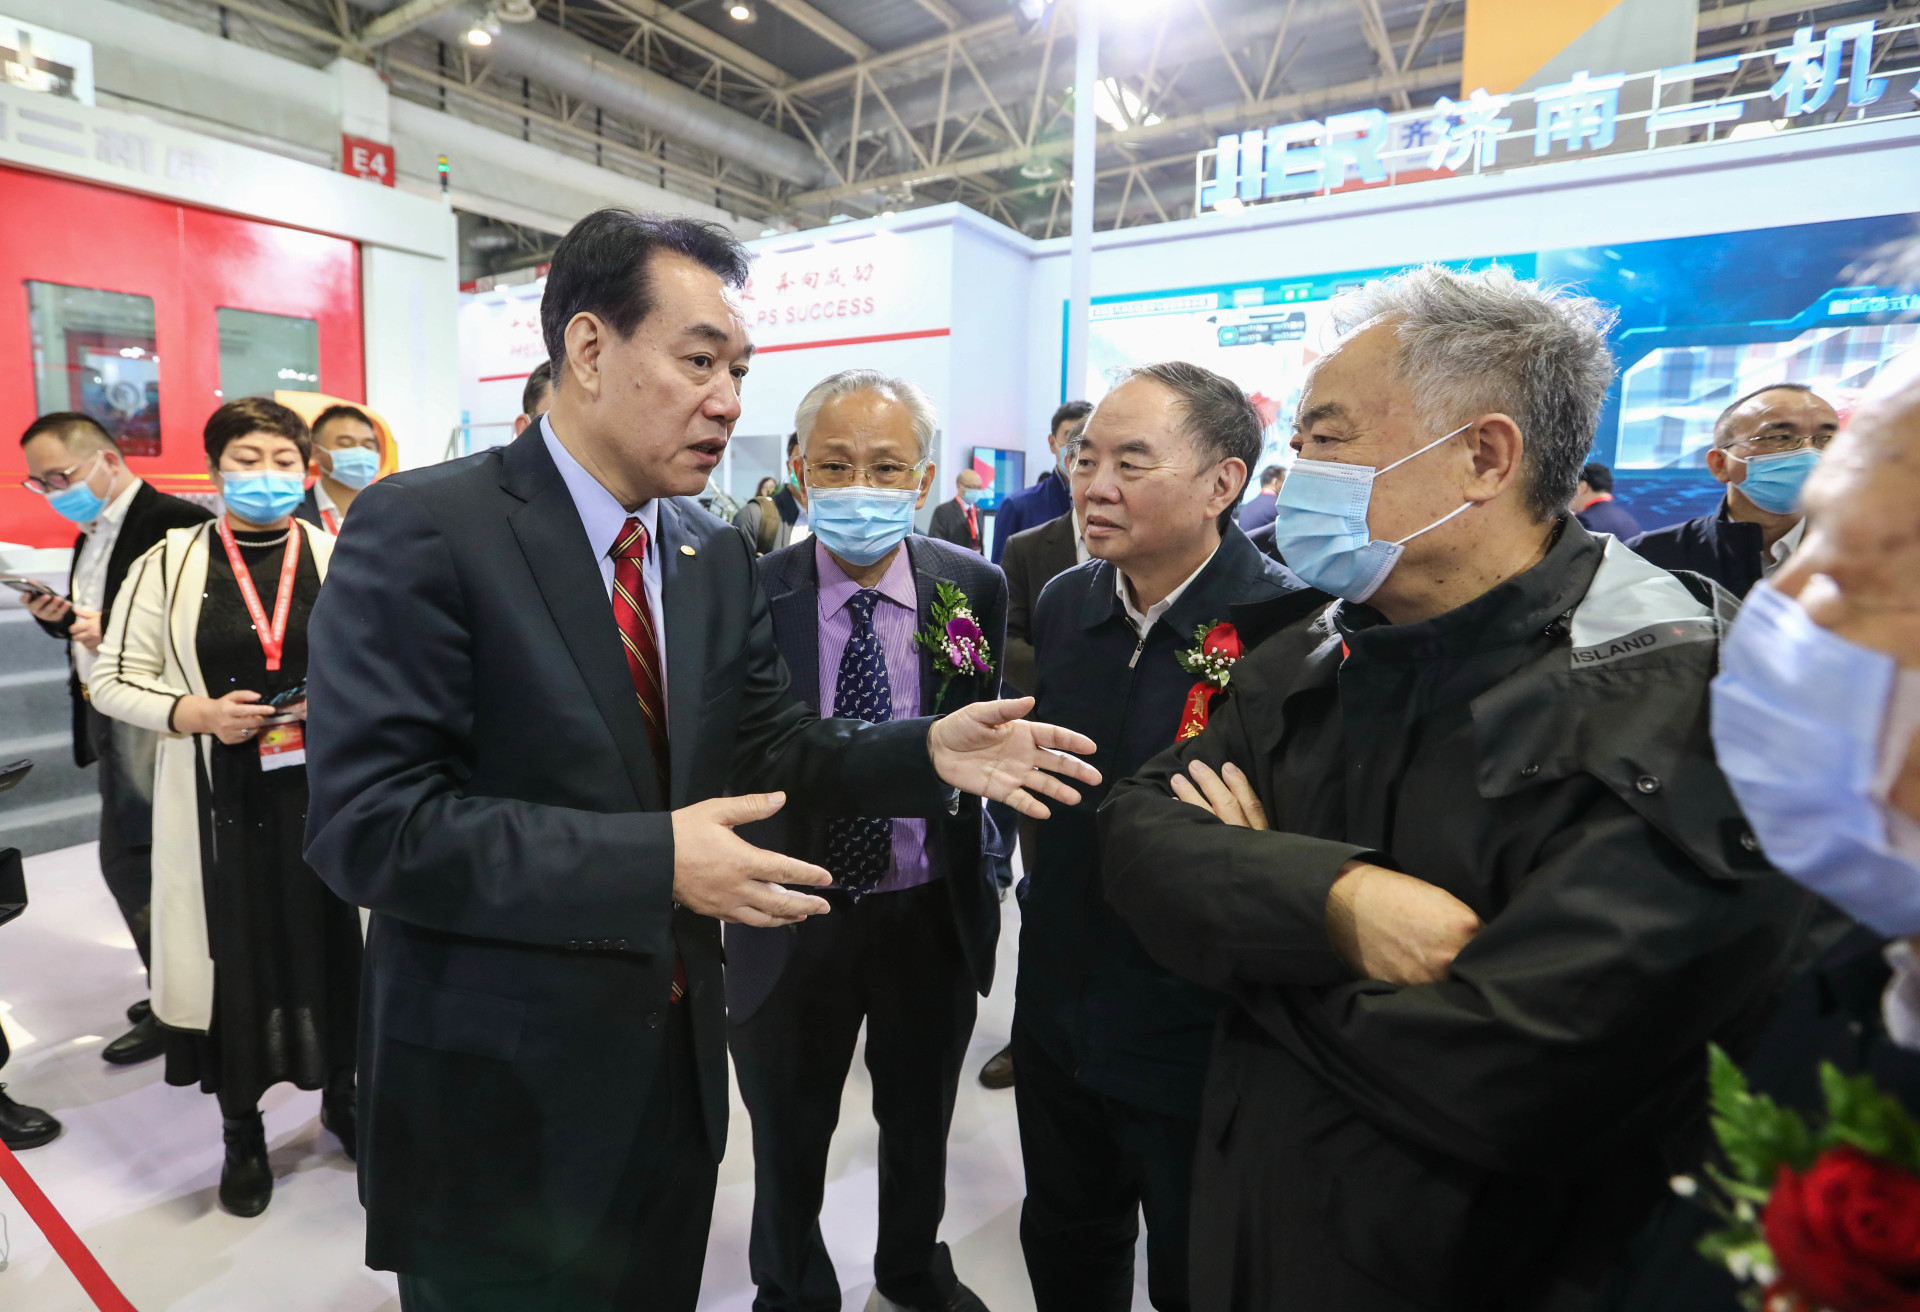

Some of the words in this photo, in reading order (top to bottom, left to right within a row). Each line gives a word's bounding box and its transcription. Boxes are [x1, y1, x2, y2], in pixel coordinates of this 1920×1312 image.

[1201, 107, 1389, 208] JIER
[1426, 19, 1920, 171] 济南二机
[352, 146, 387, 177] E4
[785, 296, 875, 324] SUCCESS
[1572, 633, 1657, 664] ISLAND
